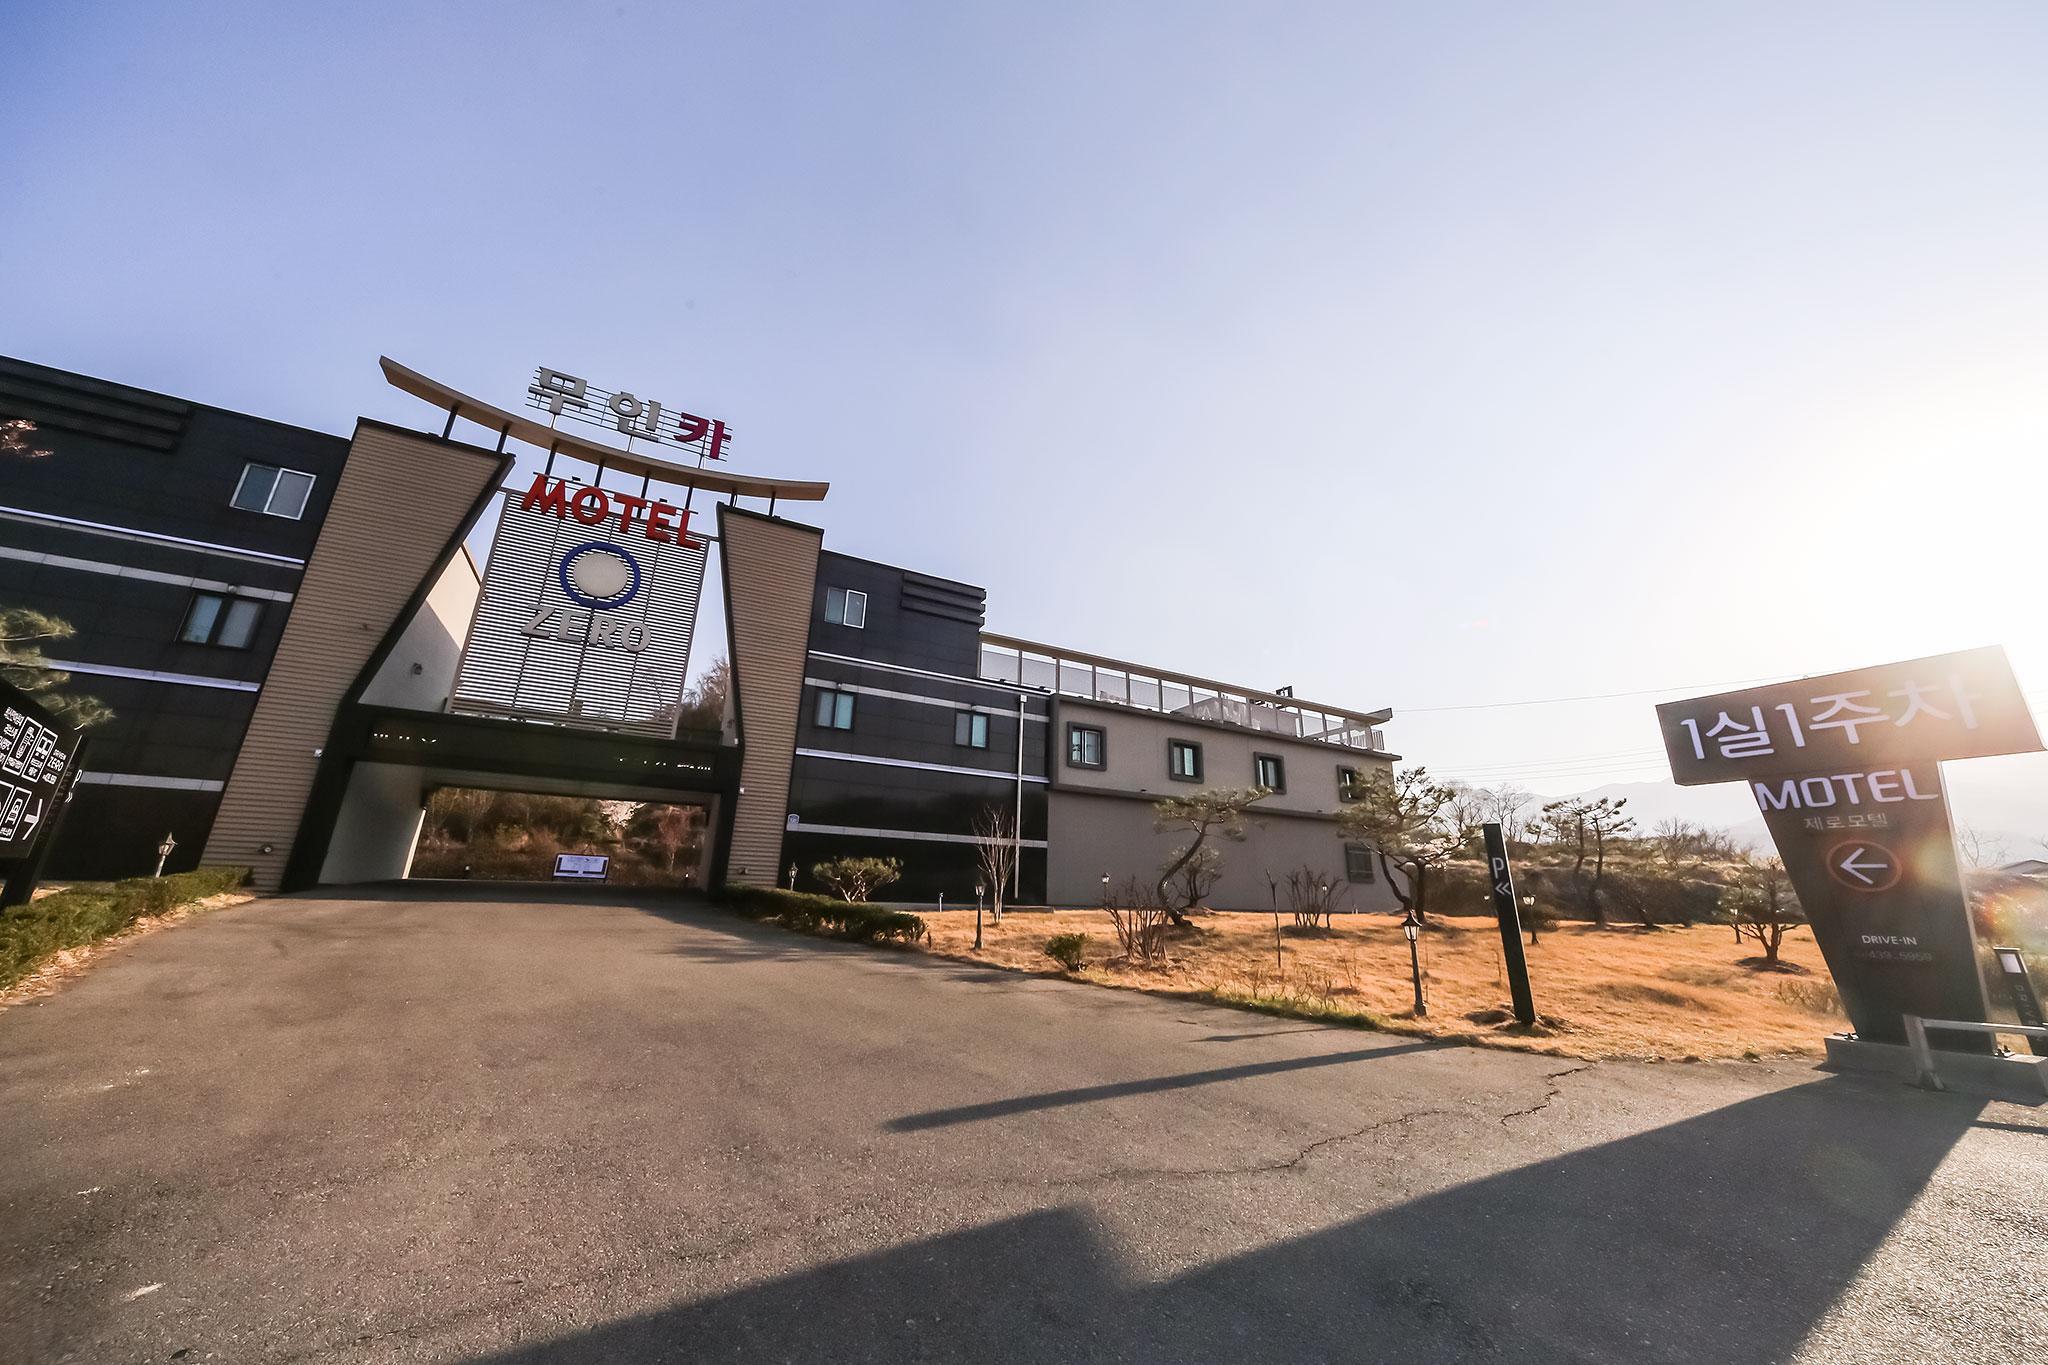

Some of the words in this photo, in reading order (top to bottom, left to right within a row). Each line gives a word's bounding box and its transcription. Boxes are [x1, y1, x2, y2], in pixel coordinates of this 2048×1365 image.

[528, 366, 732, 460] 무인카
[520, 473, 701, 550] MOTEL
[520, 603, 651, 653] ZERO
[47, 756, 64, 772] ZERO
[1754, 769, 1939, 811] MOTEL
[1492, 857, 1505, 879] P
[1861, 935, 1918, 946] DRIVE-IN
